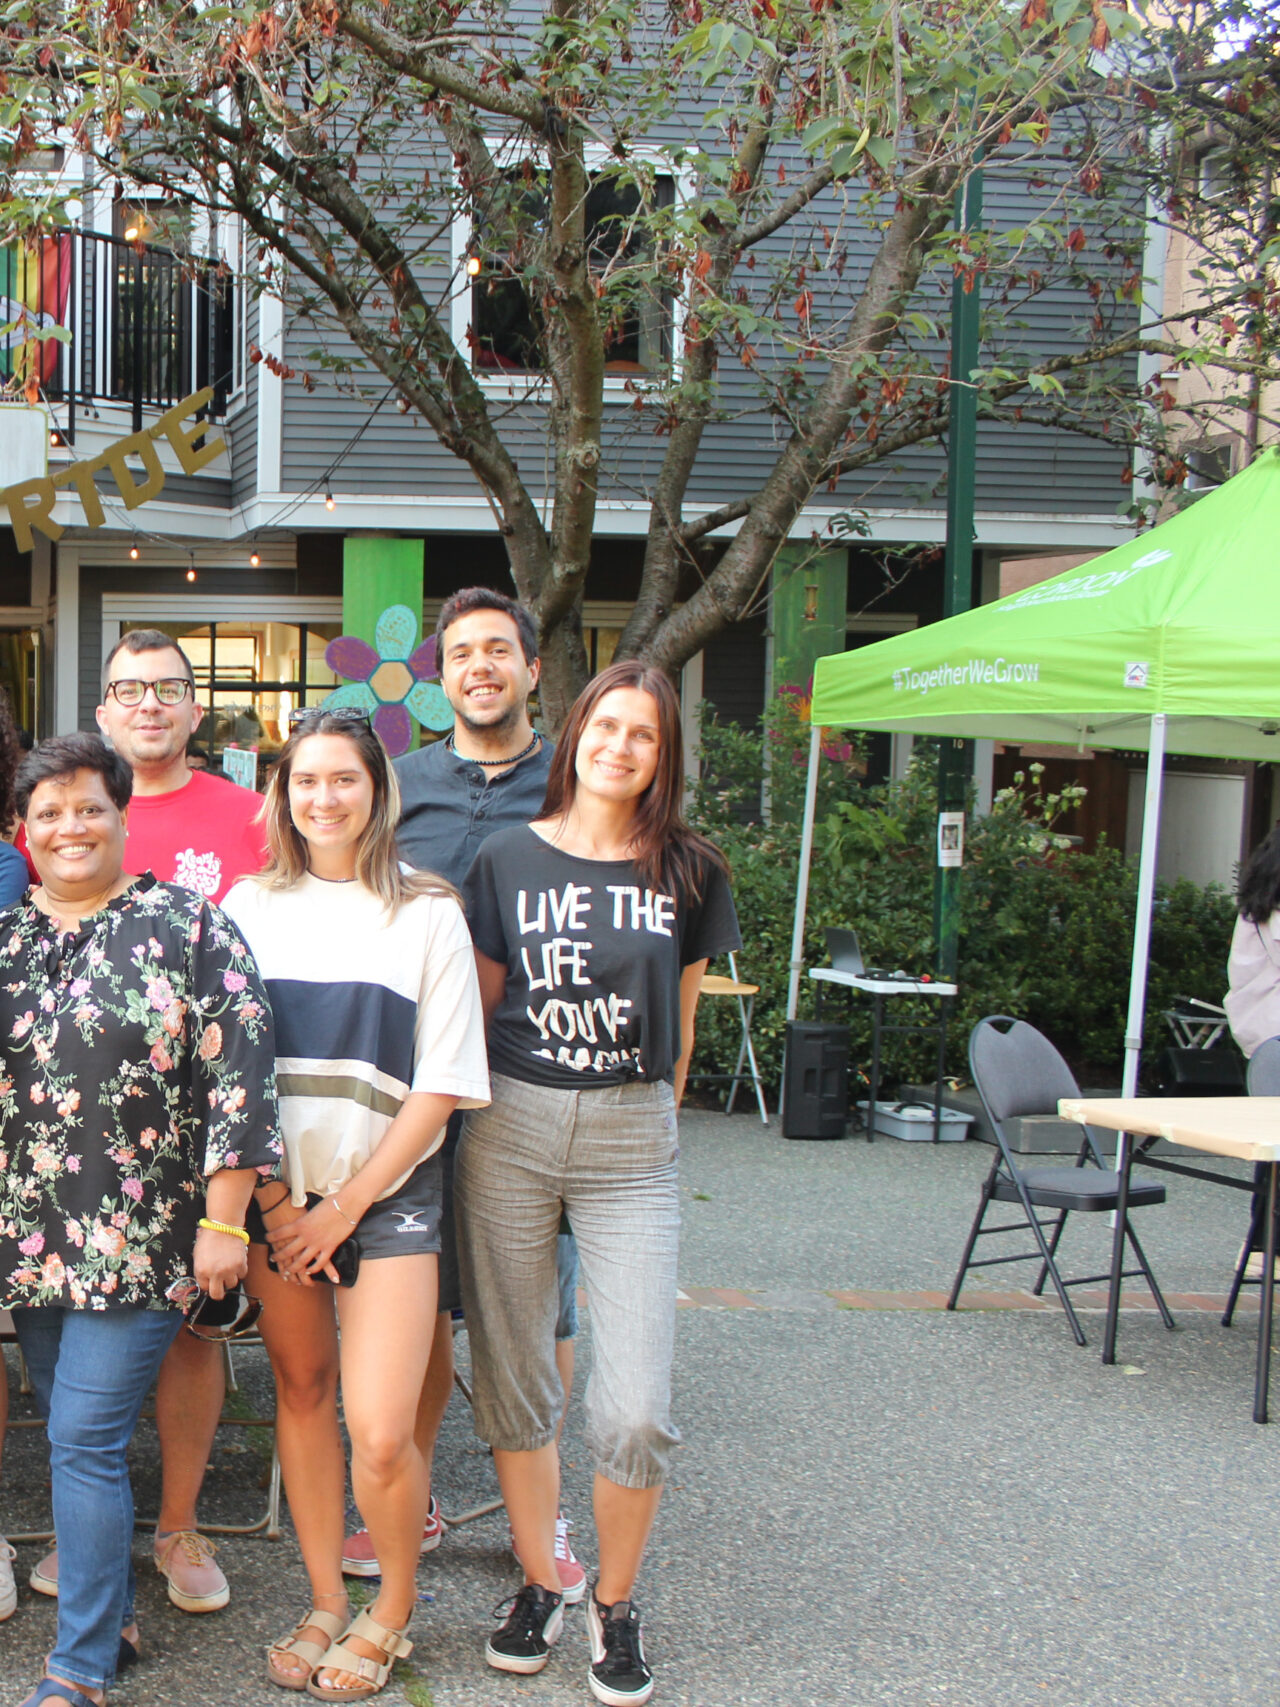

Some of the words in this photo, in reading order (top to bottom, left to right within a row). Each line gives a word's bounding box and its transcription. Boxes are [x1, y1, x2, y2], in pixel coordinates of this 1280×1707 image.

[892, 658, 1040, 694] #TogetherWeGrow
[517, 882, 592, 934] LIVE
[606, 885, 676, 937] THE
[521, 938, 593, 991] LIFE
